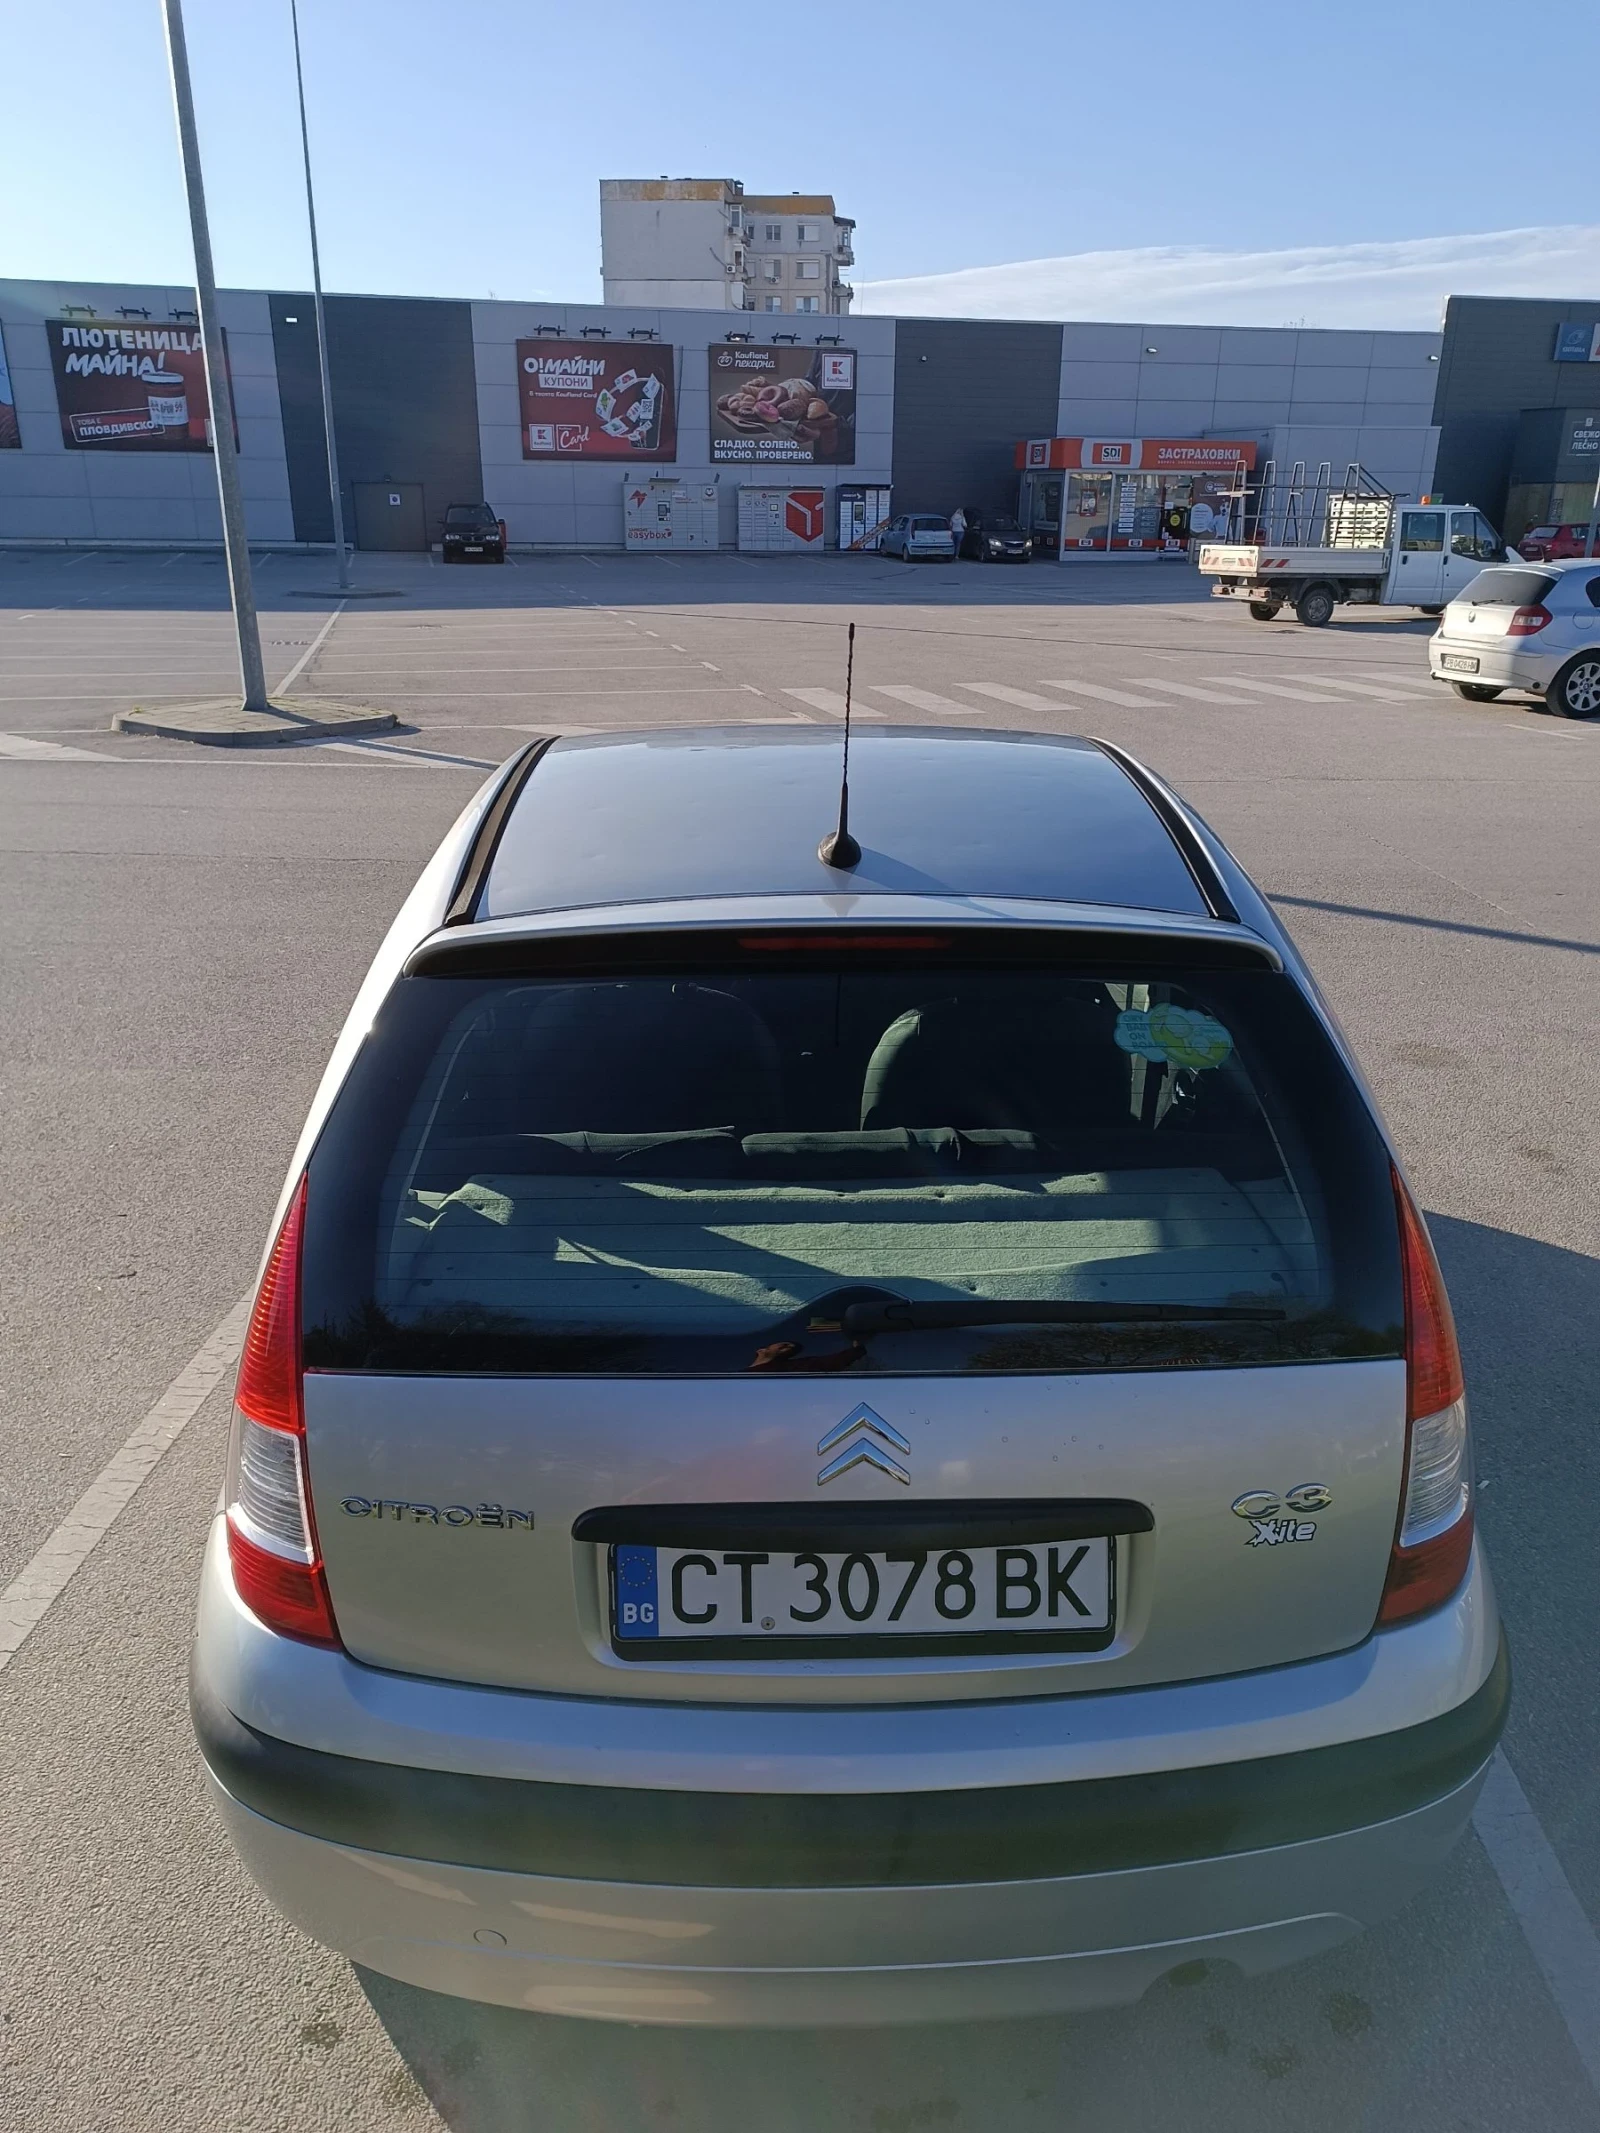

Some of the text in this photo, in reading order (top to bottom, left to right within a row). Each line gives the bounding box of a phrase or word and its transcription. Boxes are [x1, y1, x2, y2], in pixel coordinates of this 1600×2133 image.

[62, 327, 203, 355] ЛЮТЕНИЦА
[735, 351, 769, 360] Kaufland
[65, 349, 166, 377] МАЙНА!
[735, 360, 775, 369] пекарна
[544, 376, 589, 387] КУПОНИ
[560, 425, 590, 449] Card
[714, 440, 800, 449] СЛАДКО. СОЛЕНО.
[1571, 442, 1599, 450] ЛЕСНО
[714, 450, 814, 460] ВКУСНО. ПРОВЕРЕНО.
[1103, 447, 1120, 458] SDI
[1158, 448, 1240, 460] ЗАСТРАХОВКИ
[628, 531, 667, 540] easybox
[1231, 1483, 1332, 1519] C3
[340, 1496, 534, 1530] CITROËN
[671, 1545, 1092, 1623] CT 3078 BK
[623, 1603, 654, 1624] BG
